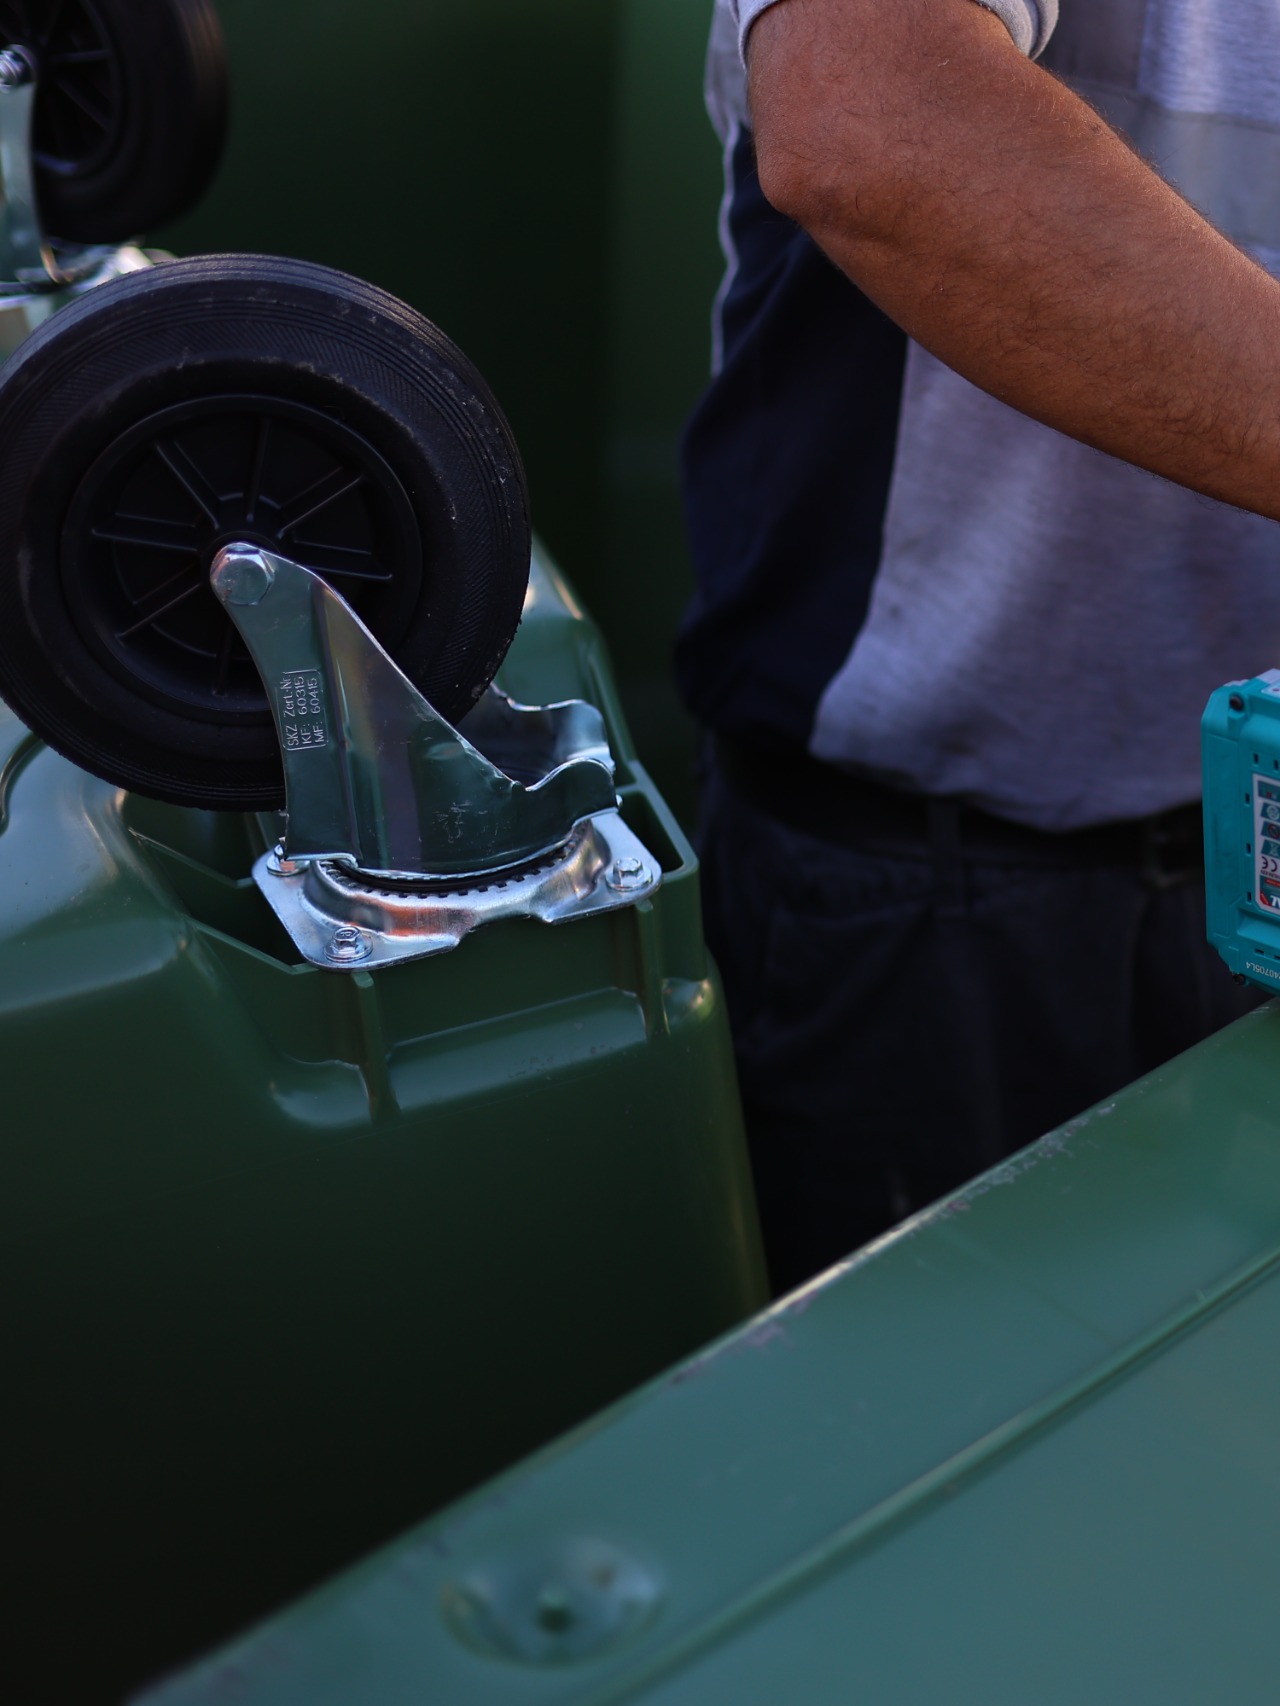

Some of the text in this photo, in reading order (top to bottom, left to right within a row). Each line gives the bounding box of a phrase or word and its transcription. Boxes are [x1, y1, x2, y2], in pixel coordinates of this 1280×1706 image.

[286, 724, 299, 746] SKZ
[294, 676, 312, 745] KF: 60315
[307, 677, 325, 743] MF: 60415
